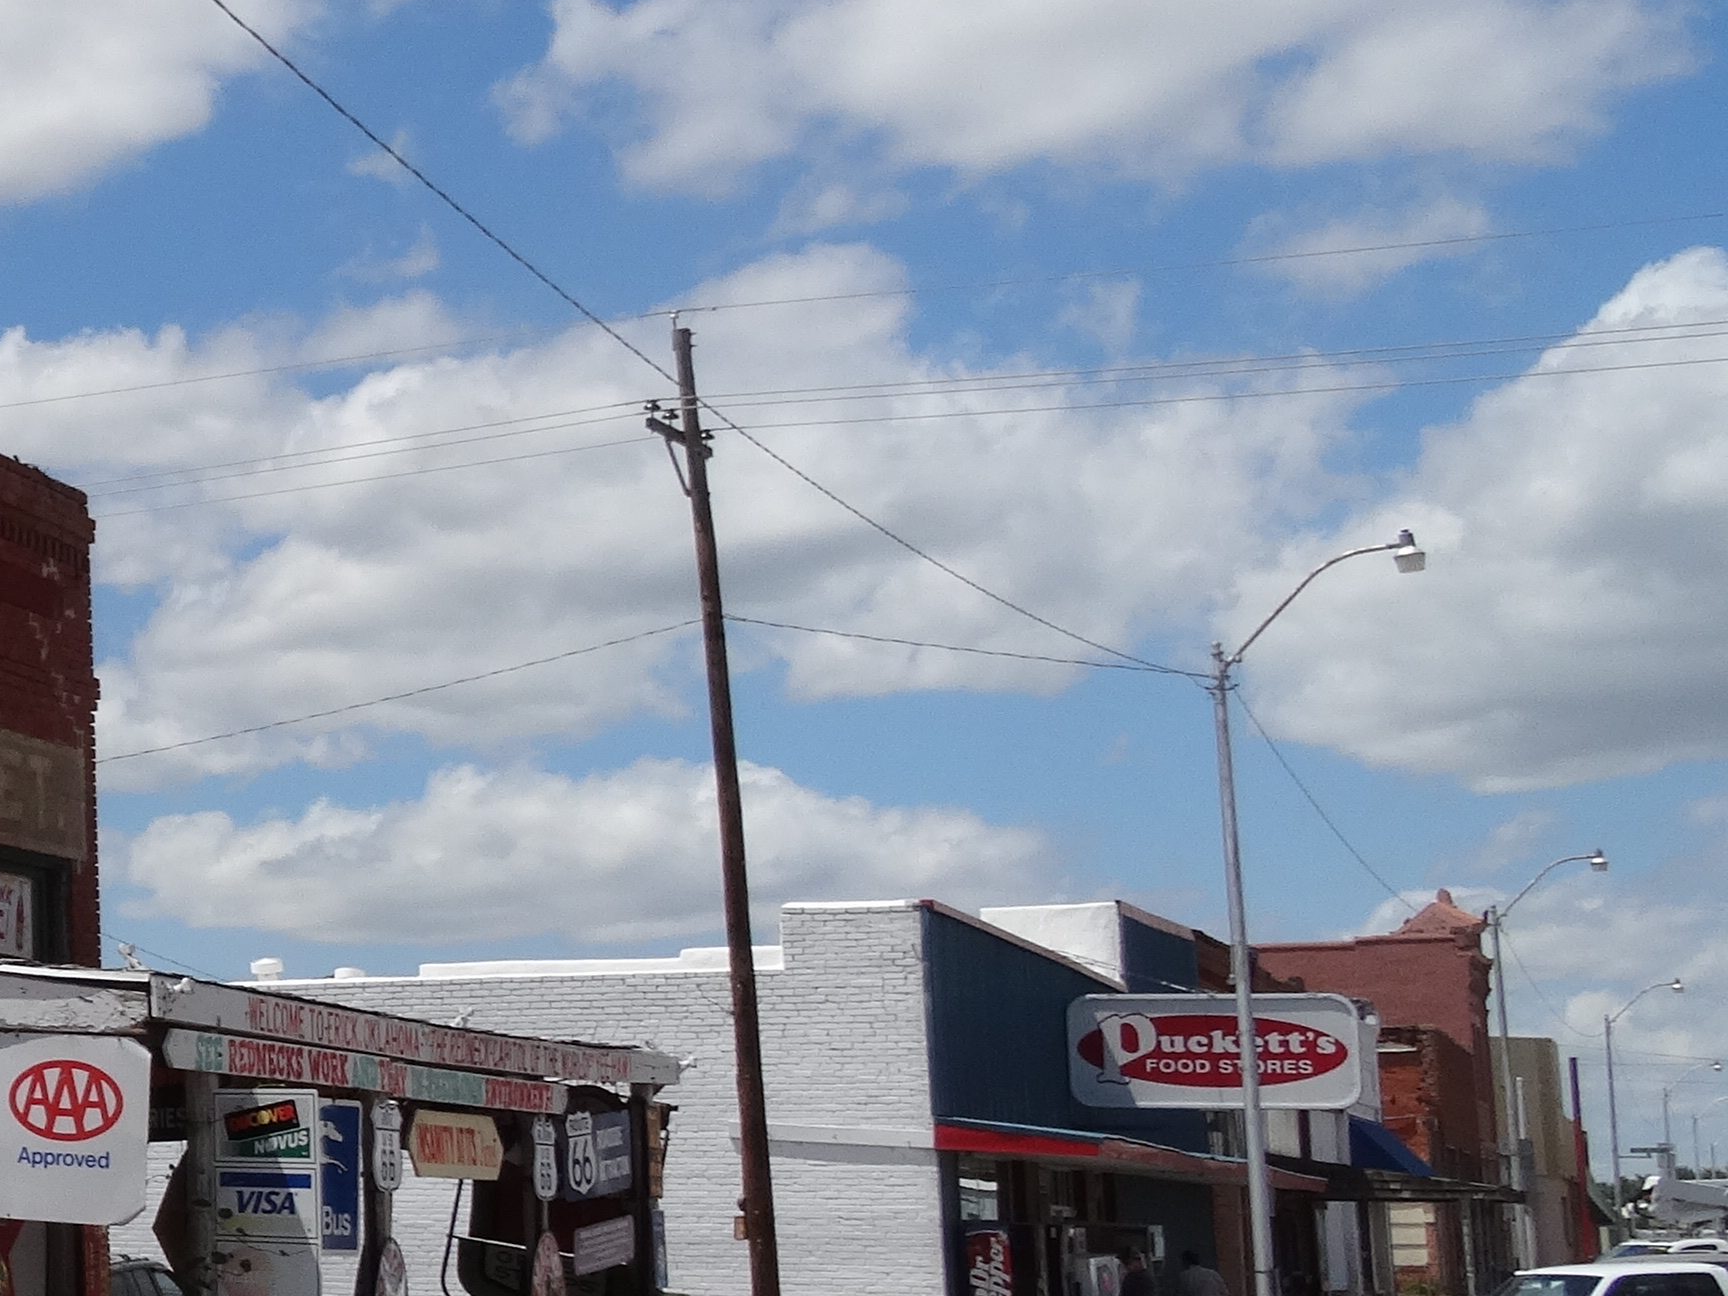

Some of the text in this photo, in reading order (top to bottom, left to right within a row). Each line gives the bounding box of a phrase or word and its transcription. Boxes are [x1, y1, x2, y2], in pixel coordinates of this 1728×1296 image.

[247, 996, 306, 1038] WELCOME
[195, 1034, 225, 1072] SEE
[227, 1039, 306, 1081] REDNECKS
[308, 1051, 350, 1087] WORK
[1144, 1057, 1211, 1075] FOOD
[18, 1061, 116, 1142] AAA
[17, 1145, 111, 1171] Approved
[253, 1130, 310, 1155] NOVUS
[572, 1139, 593, 1187] 66
[235, 1190, 298, 1215] VISA
[322, 1205, 352, 1236] Bus
